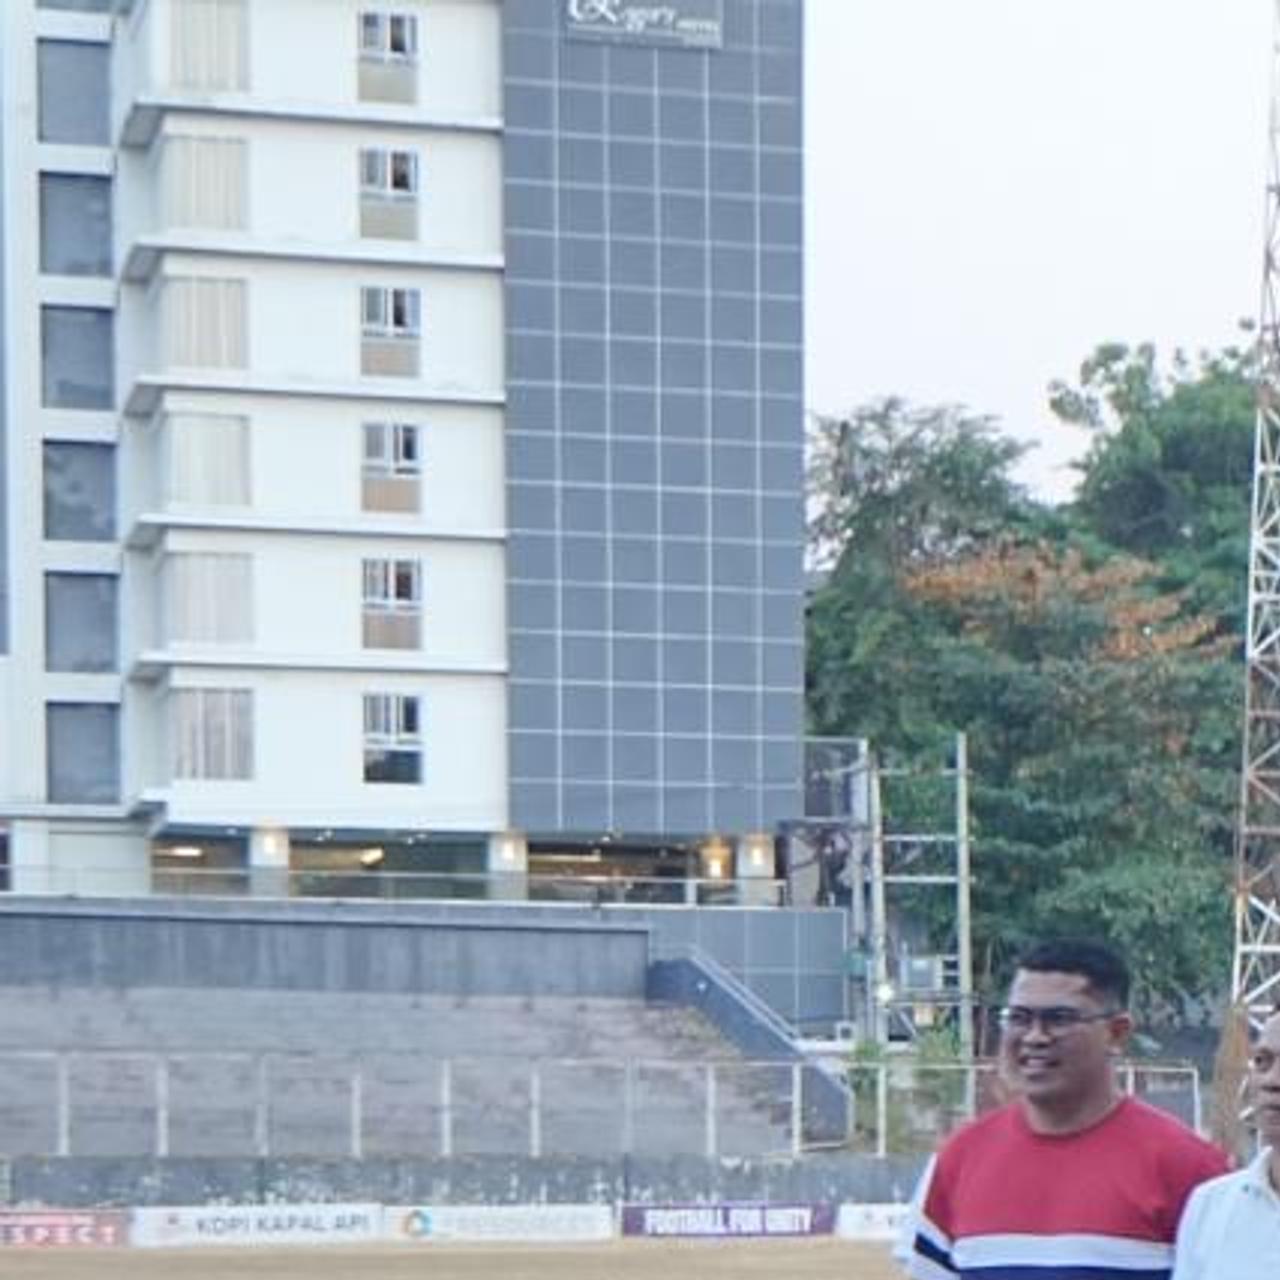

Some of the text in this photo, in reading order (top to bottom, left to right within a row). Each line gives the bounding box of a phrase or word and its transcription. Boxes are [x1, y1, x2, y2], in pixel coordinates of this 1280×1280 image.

[197, 1213, 369, 1233] KOPI KAPAL API
[644, 1207, 813, 1234] FOOTBALL FOR UNITY
[0, 1226, 117, 1244] SPECT
